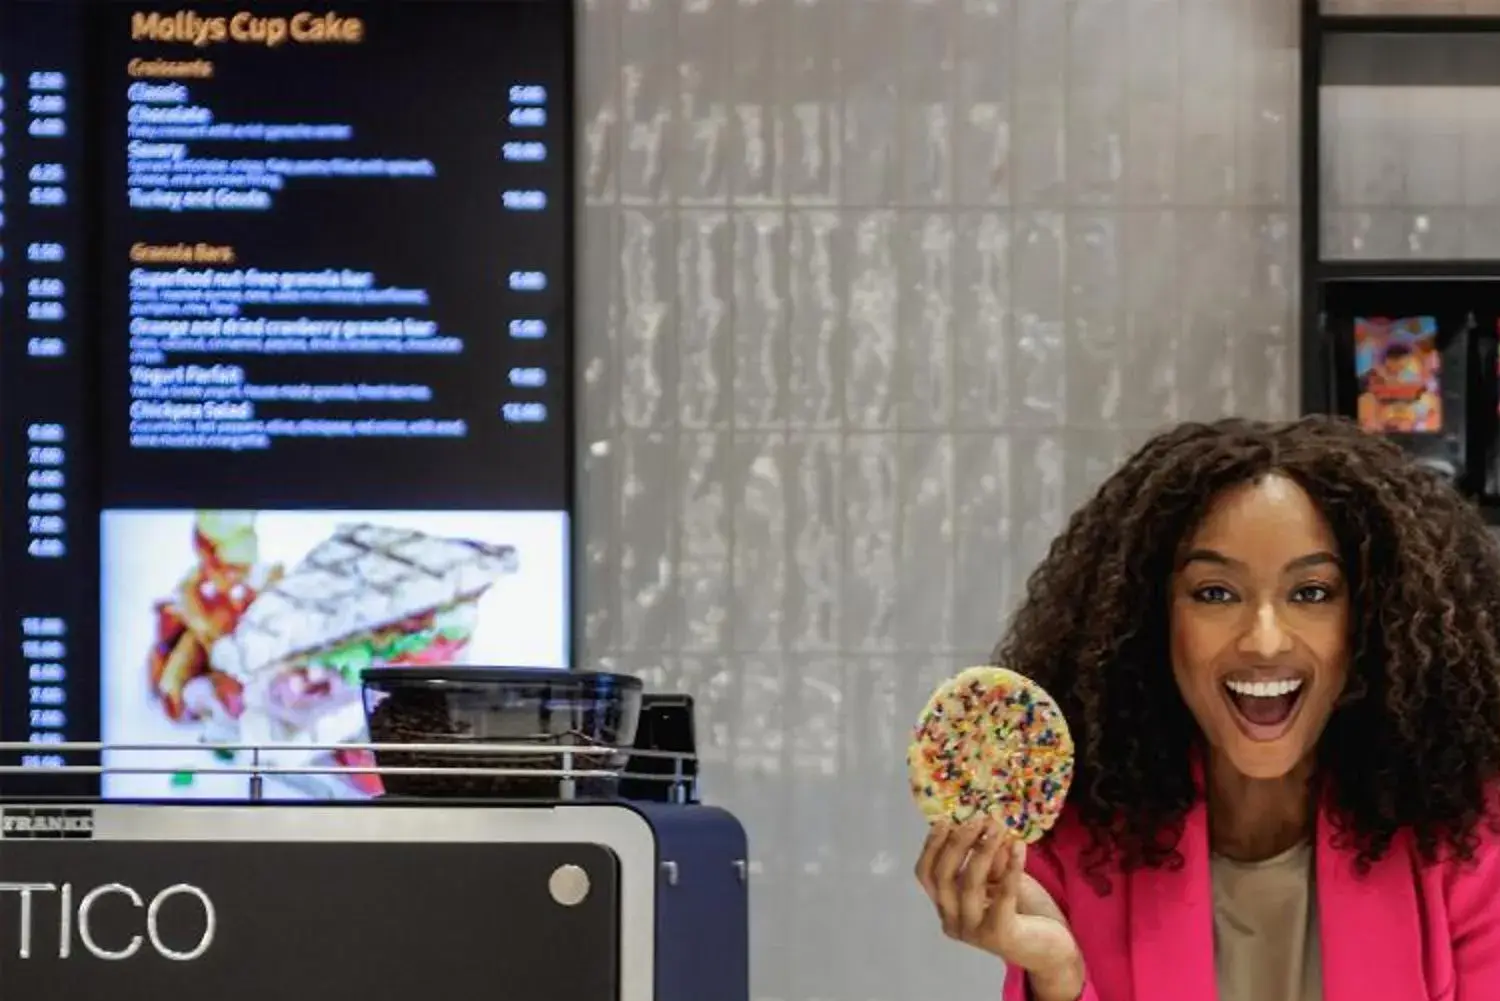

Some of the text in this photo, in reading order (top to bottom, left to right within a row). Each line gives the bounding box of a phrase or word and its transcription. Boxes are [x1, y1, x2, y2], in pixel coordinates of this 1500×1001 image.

[131, 10, 365, 47] Mollys Cup Cake
[128, 58, 214, 78] Croissants
[128, 82, 188, 103] Classic
[128, 104, 213, 124] Chocolate
[128, 140, 188, 162] Savory
[128, 188, 272, 212] Turkey and Gouda
[129, 242, 236, 264] Granola Bars
[129, 267, 213, 288] Superfood
[279, 268, 340, 292] granola
[340, 268, 375, 289] bar
[129, 317, 440, 340] Orange and dried cranberry granola bar
[129, 364, 245, 388] Yogurt Parfait
[129, 400, 254, 423] Chickpea Salad
